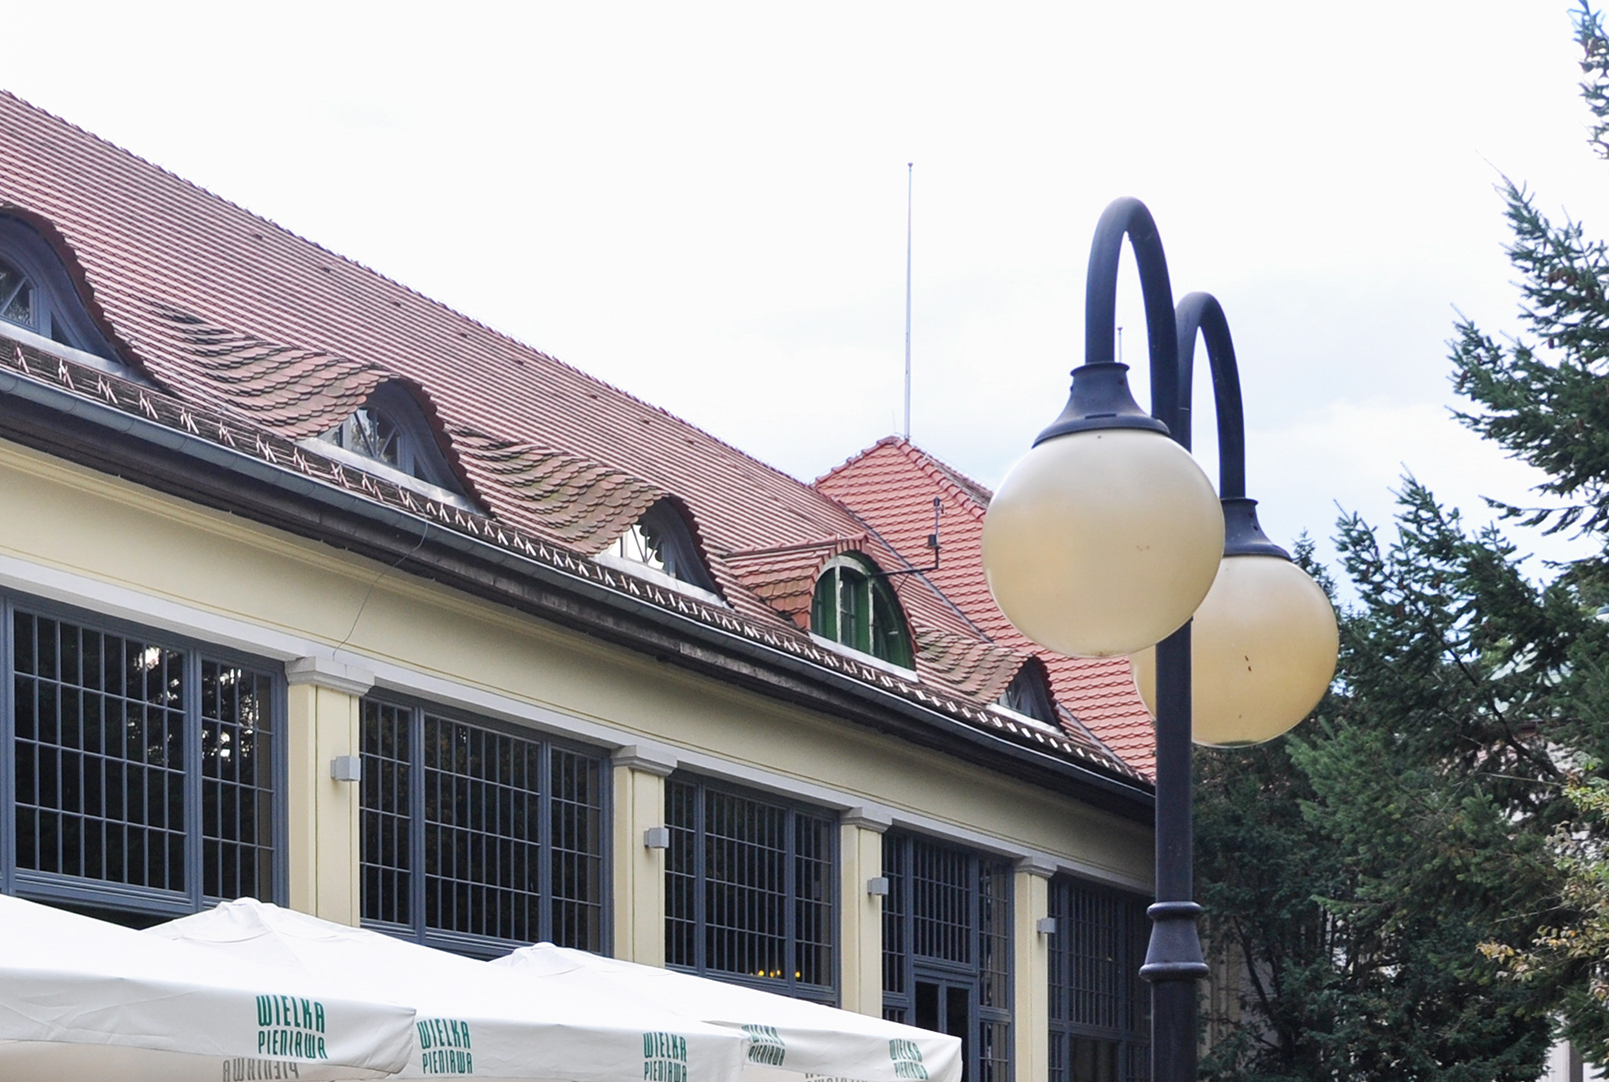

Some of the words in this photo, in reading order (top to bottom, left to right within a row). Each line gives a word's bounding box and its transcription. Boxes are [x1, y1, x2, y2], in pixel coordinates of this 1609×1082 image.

[256, 995, 325, 1033] WIELKA
[258, 1030, 328, 1059] PIENIAWA
[417, 1019, 471, 1049] WIELKA
[643, 1032, 687, 1062] WIELKA
[422, 1050, 473, 1074] PIENIAWA
[748, 1045, 786, 1066] PIENIAWA
[889, 1039, 923, 1062] WIELKA
